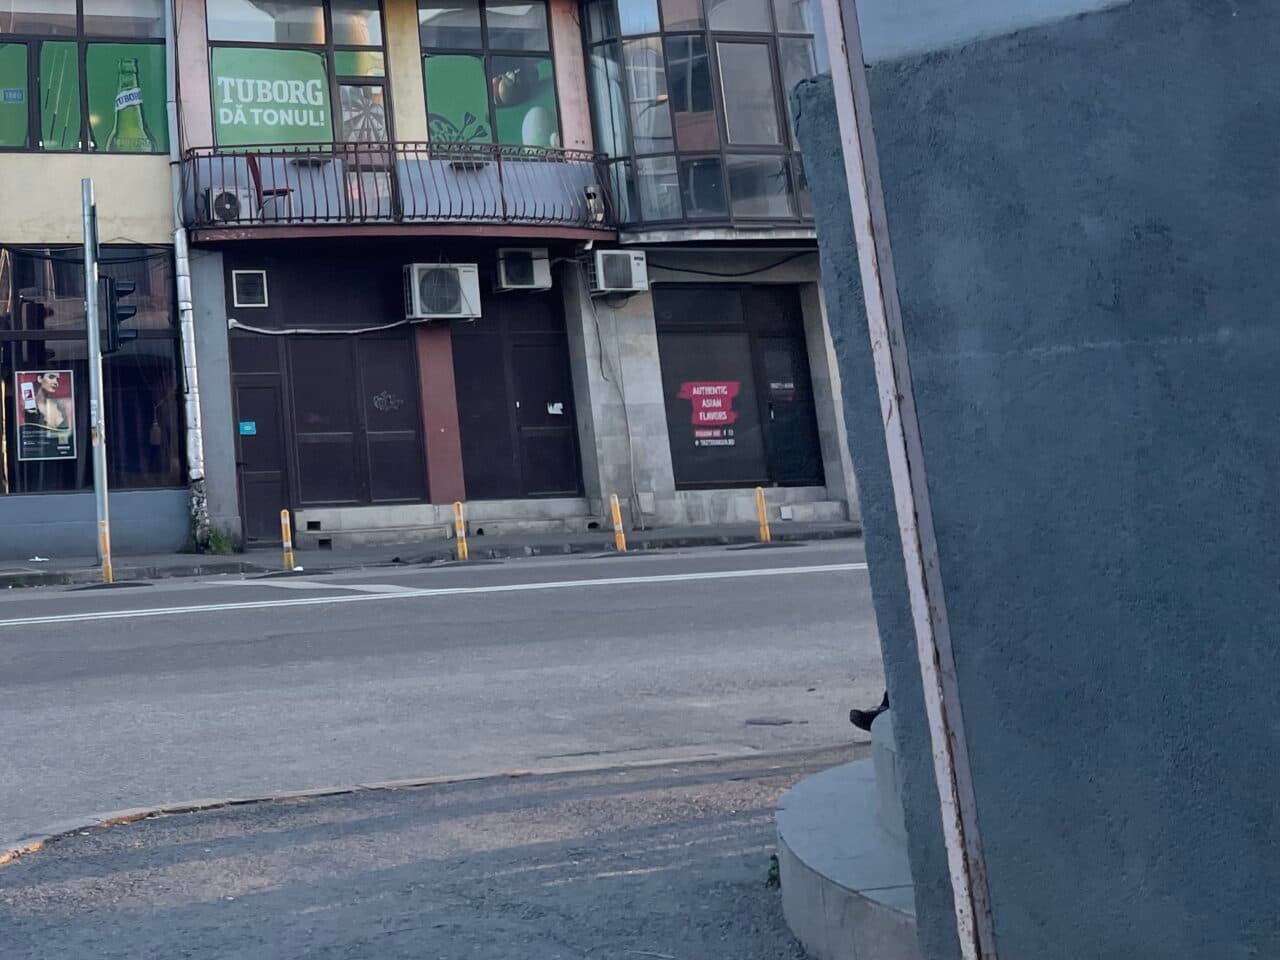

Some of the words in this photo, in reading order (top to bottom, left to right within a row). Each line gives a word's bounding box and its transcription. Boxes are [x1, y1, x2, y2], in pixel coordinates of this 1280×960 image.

[217, 77, 323, 105] TUBORG
[220, 104, 247, 125] DĂ
[250, 108, 325, 127] TONUL!
[692, 386, 728, 395] AUTHENTIC
[702, 399, 722, 408] ASIAN
